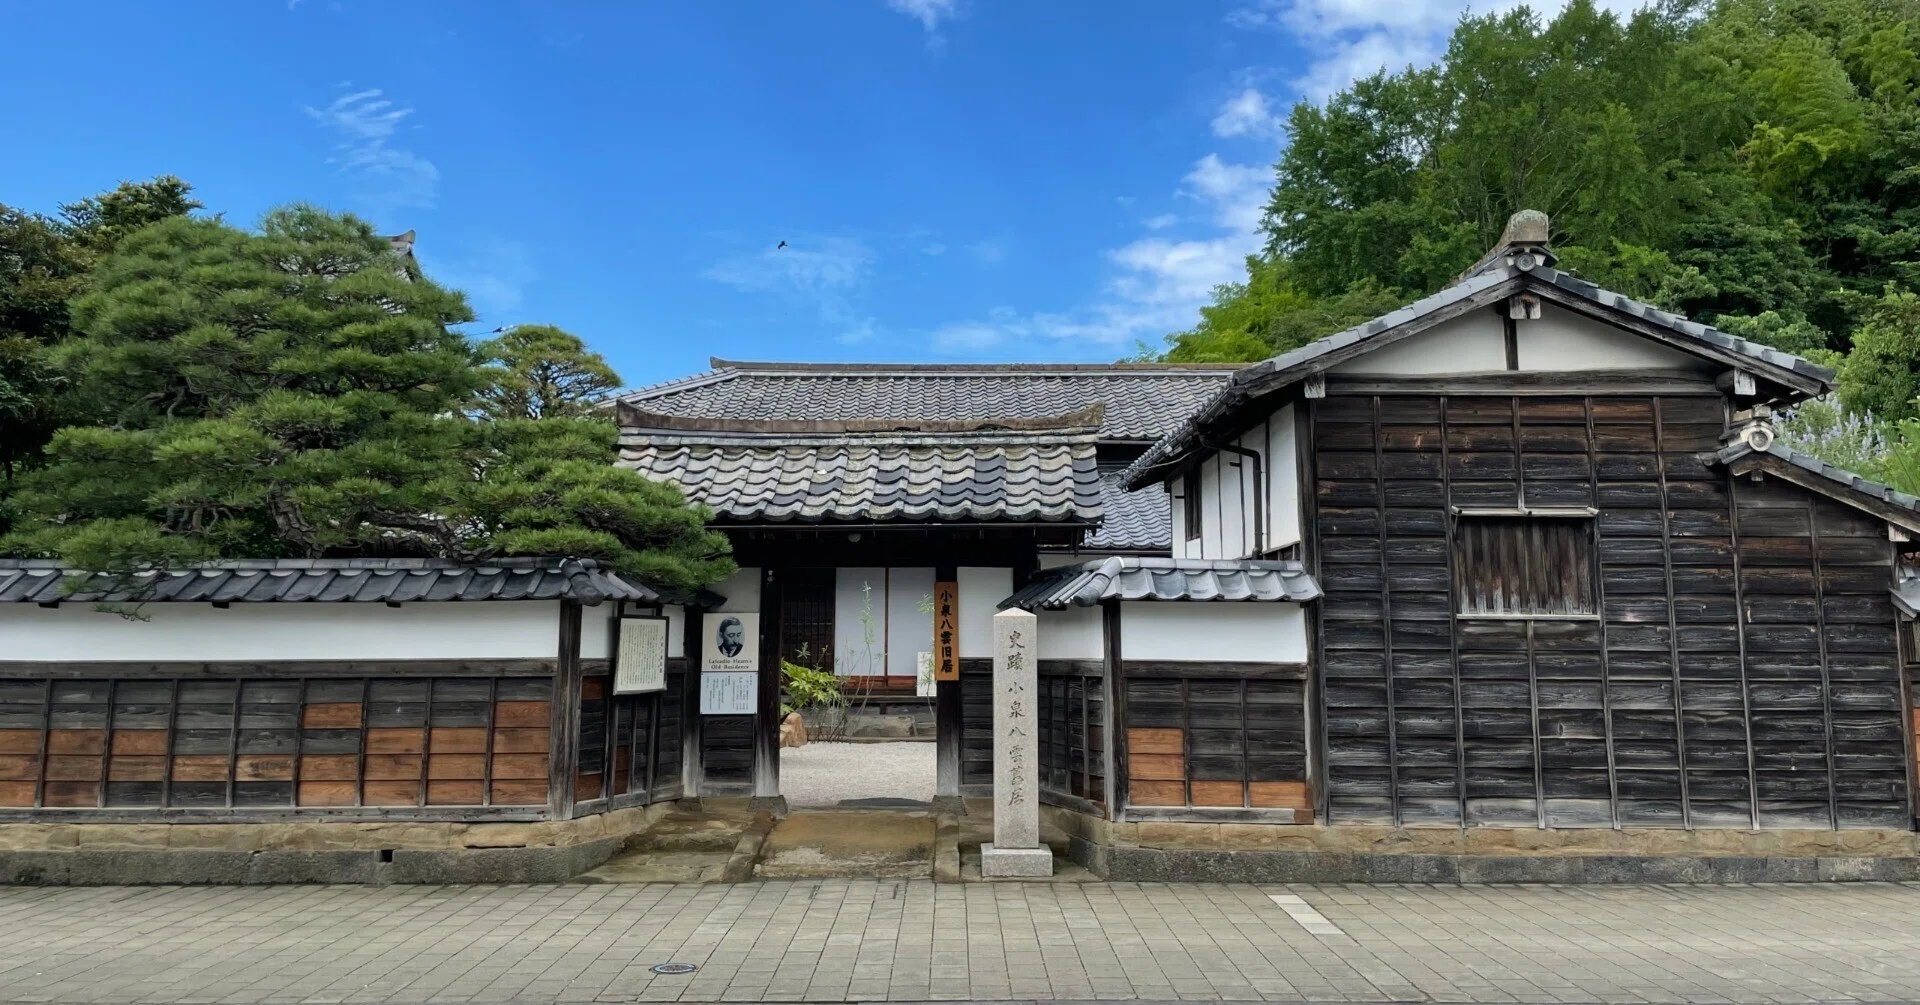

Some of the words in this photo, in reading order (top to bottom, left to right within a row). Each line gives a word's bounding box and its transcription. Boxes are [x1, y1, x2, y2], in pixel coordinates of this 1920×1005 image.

[940, 590, 953, 673] 小泉八雲旧居
